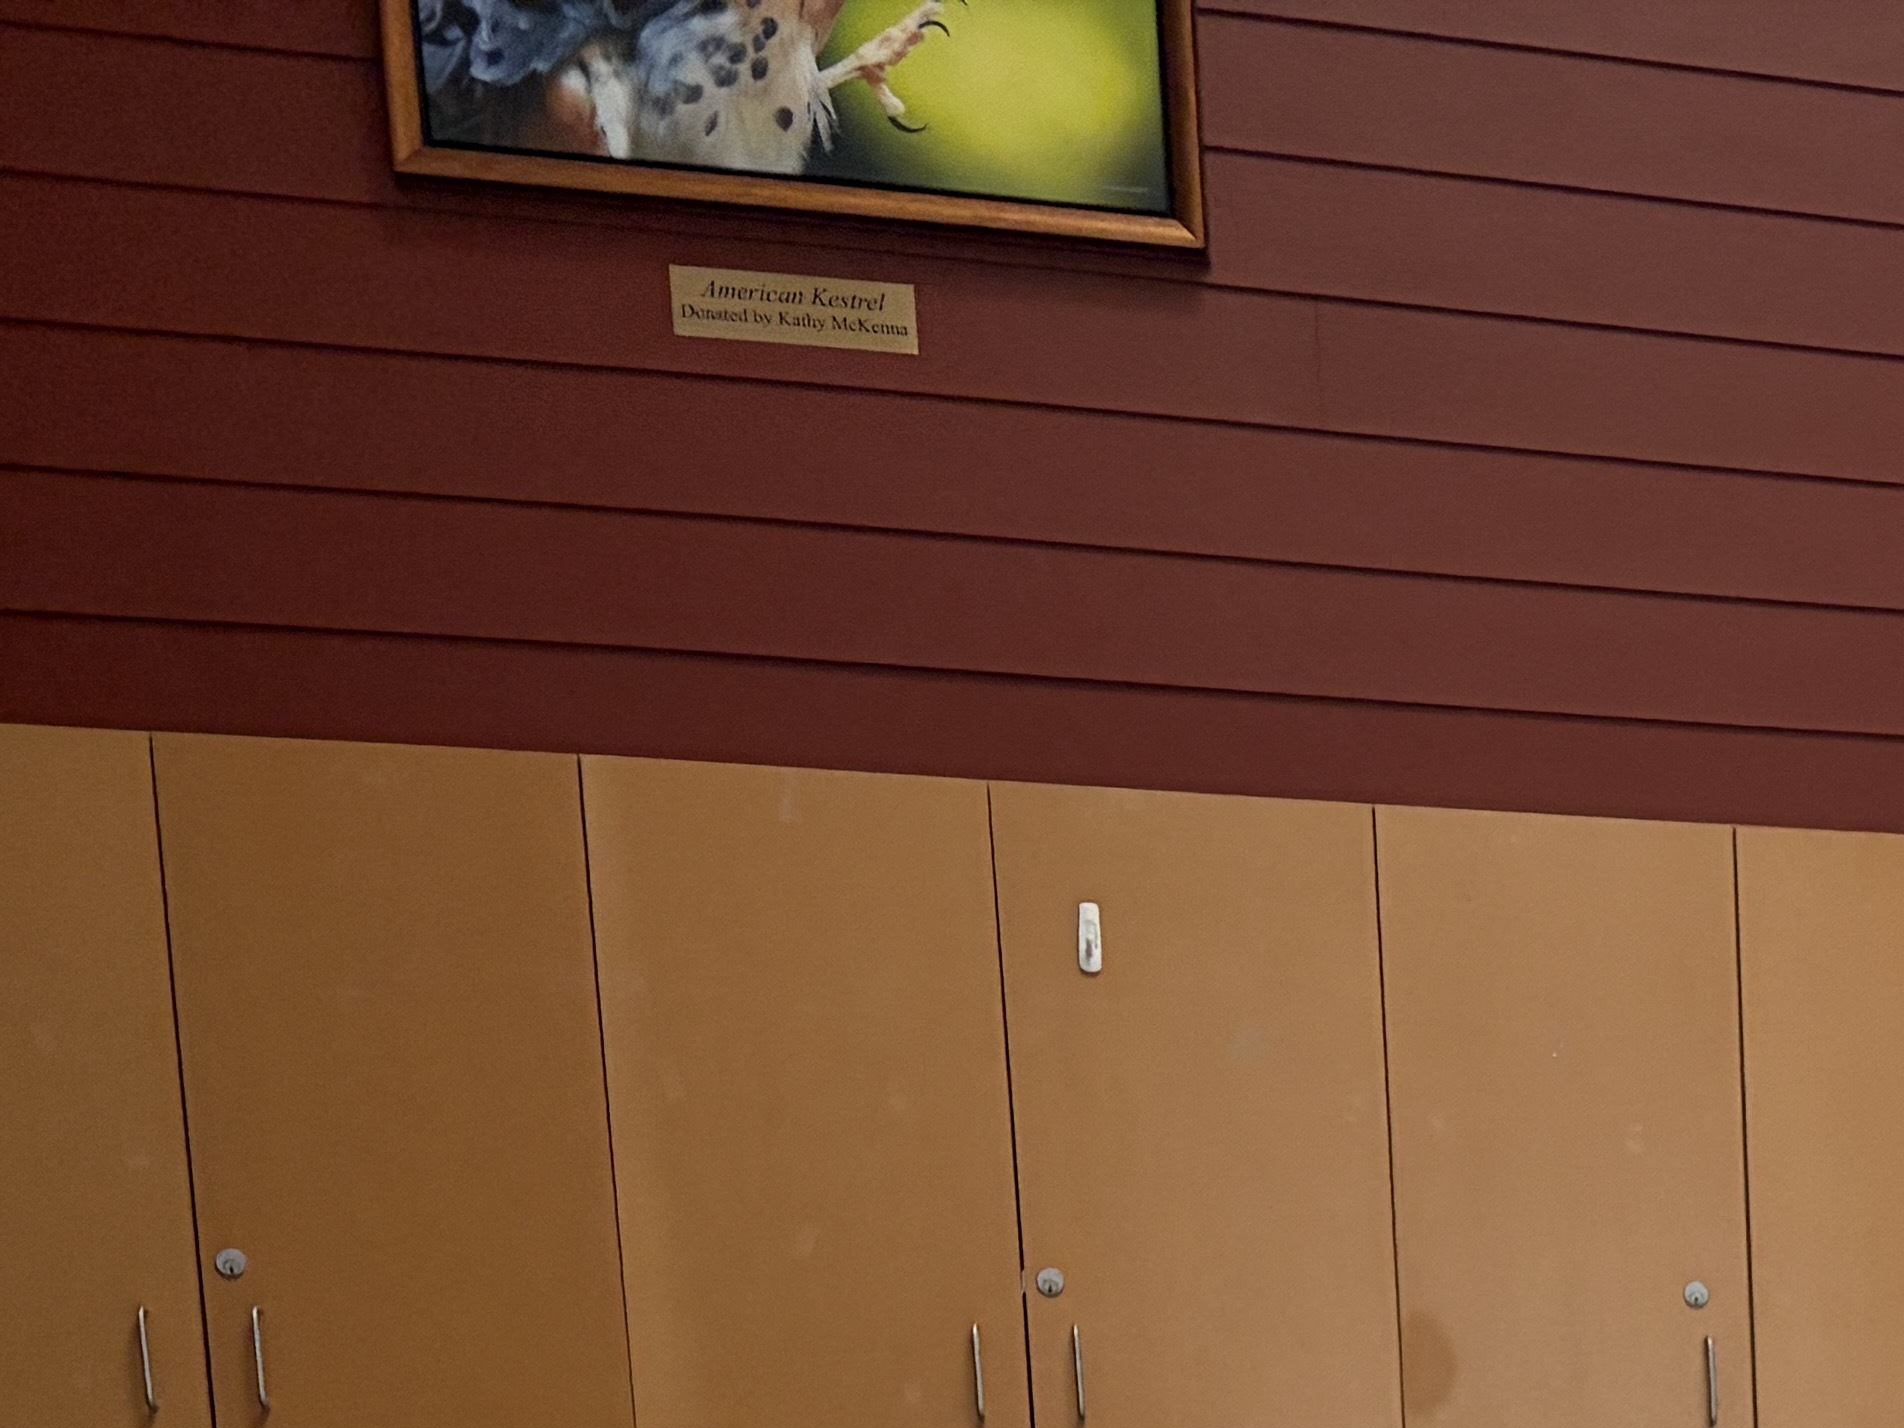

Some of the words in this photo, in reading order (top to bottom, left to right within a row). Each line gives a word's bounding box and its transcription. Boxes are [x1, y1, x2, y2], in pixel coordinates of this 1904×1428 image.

[701, 280, 804, 305] American
[811, 287, 885, 312] Kestrel
[753, 309, 772, 325] by
[778, 311, 826, 333] Kathy
[832, 315, 908, 337] McKenna
